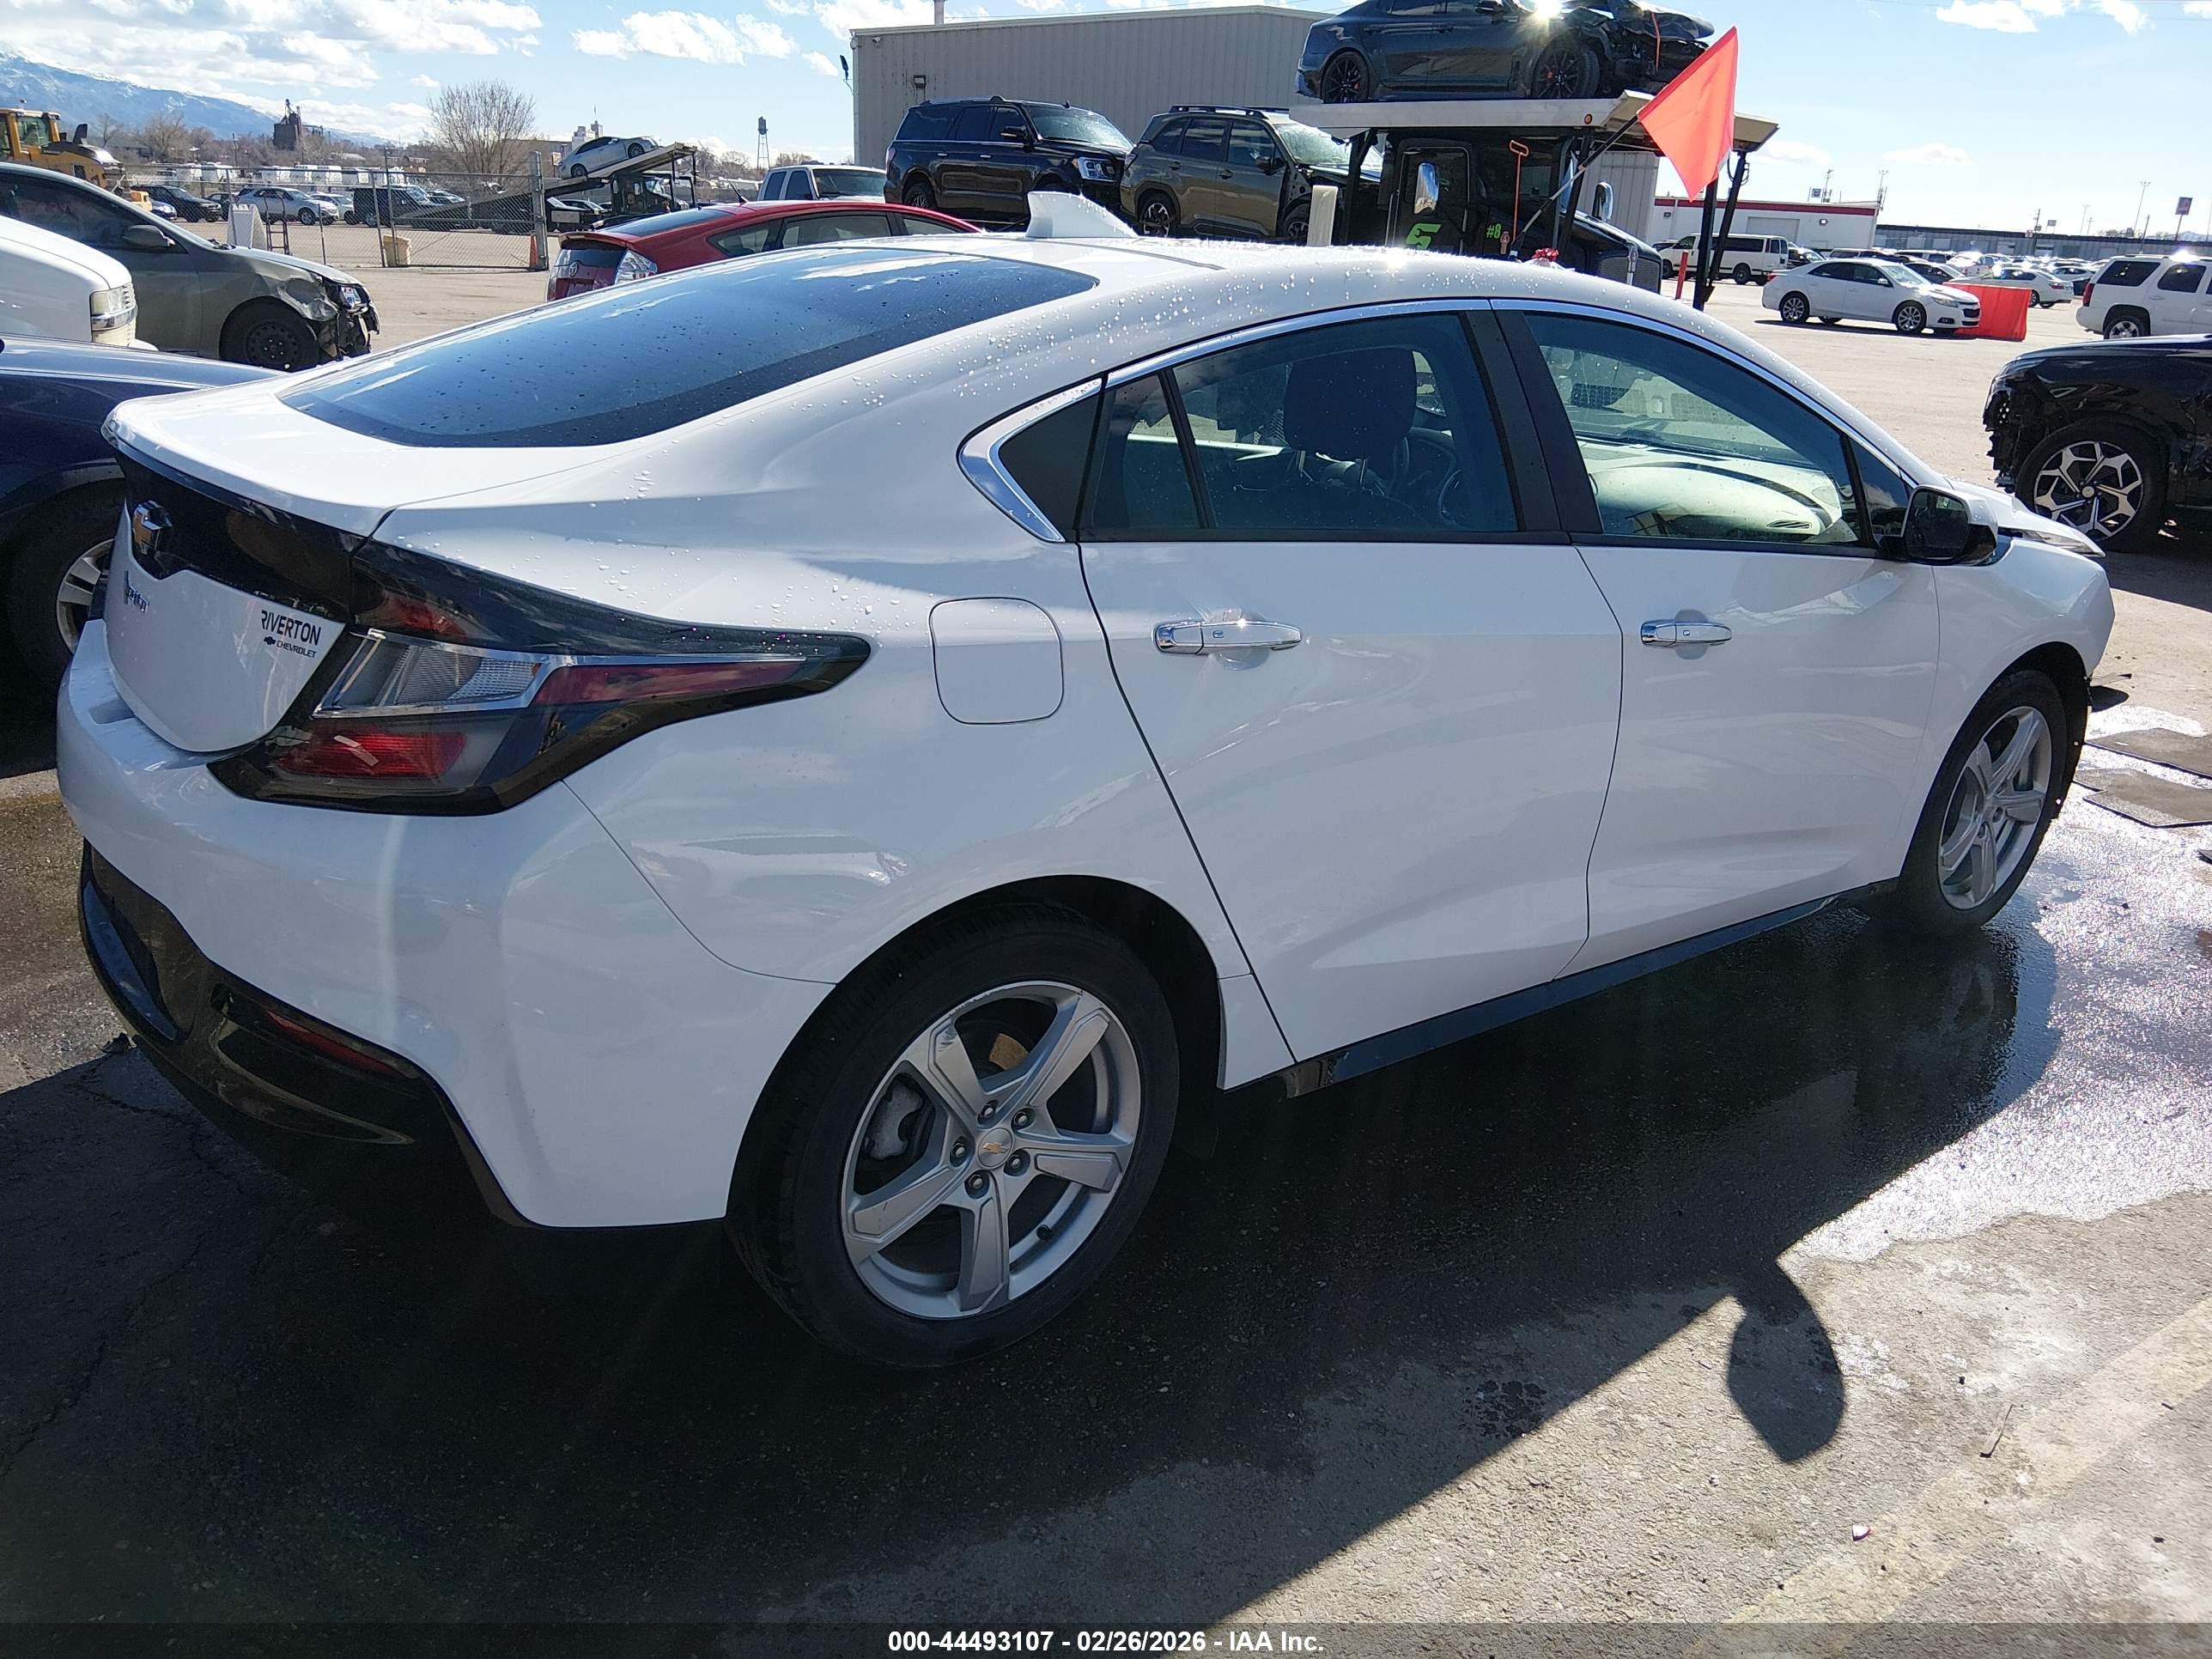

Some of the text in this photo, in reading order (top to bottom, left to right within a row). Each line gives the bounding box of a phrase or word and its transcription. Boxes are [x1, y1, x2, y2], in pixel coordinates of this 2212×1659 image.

[1486, 223, 1502, 239] #8
[261, 610, 321, 646] RIVERTON
[276, 640, 317, 658] CHEVROLET
